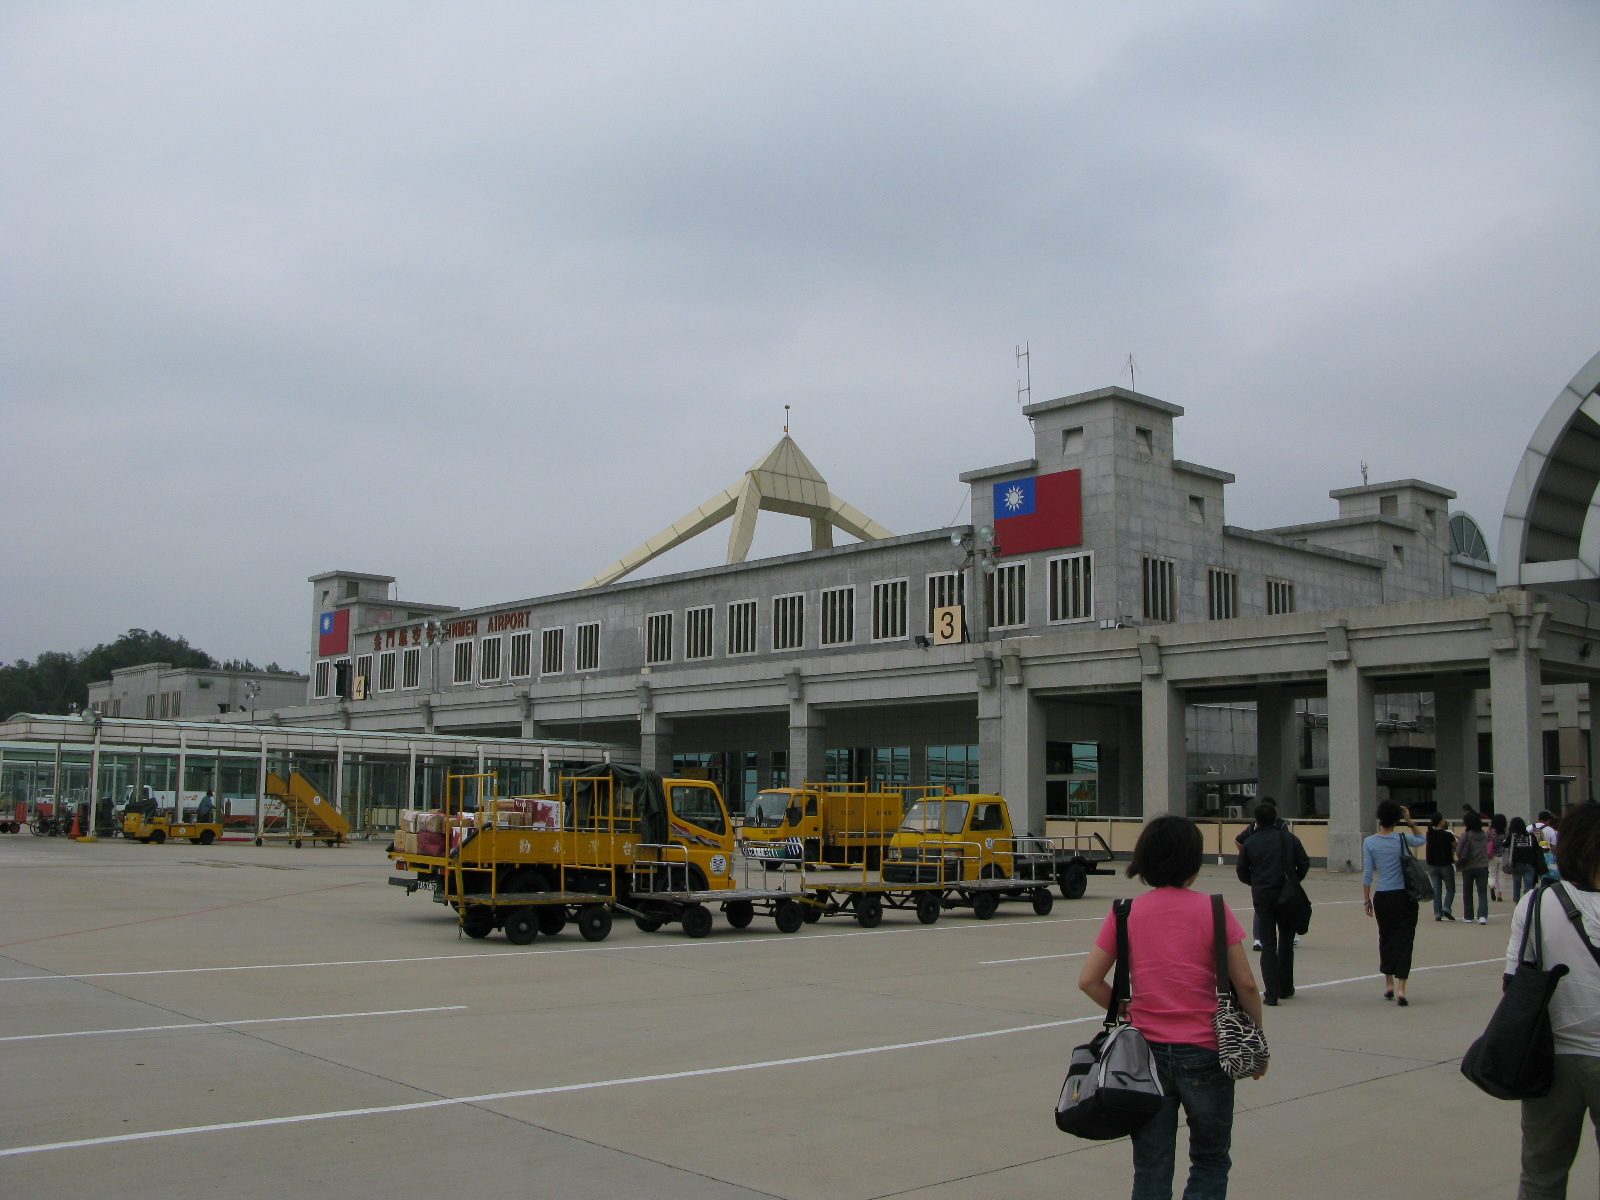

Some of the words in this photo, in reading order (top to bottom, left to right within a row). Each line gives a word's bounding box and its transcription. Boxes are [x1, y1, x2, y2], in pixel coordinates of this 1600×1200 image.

[487, 611, 532, 633] AIRPORT
[940, 611, 955, 640] 3
[355, 679, 362, 697] 4
